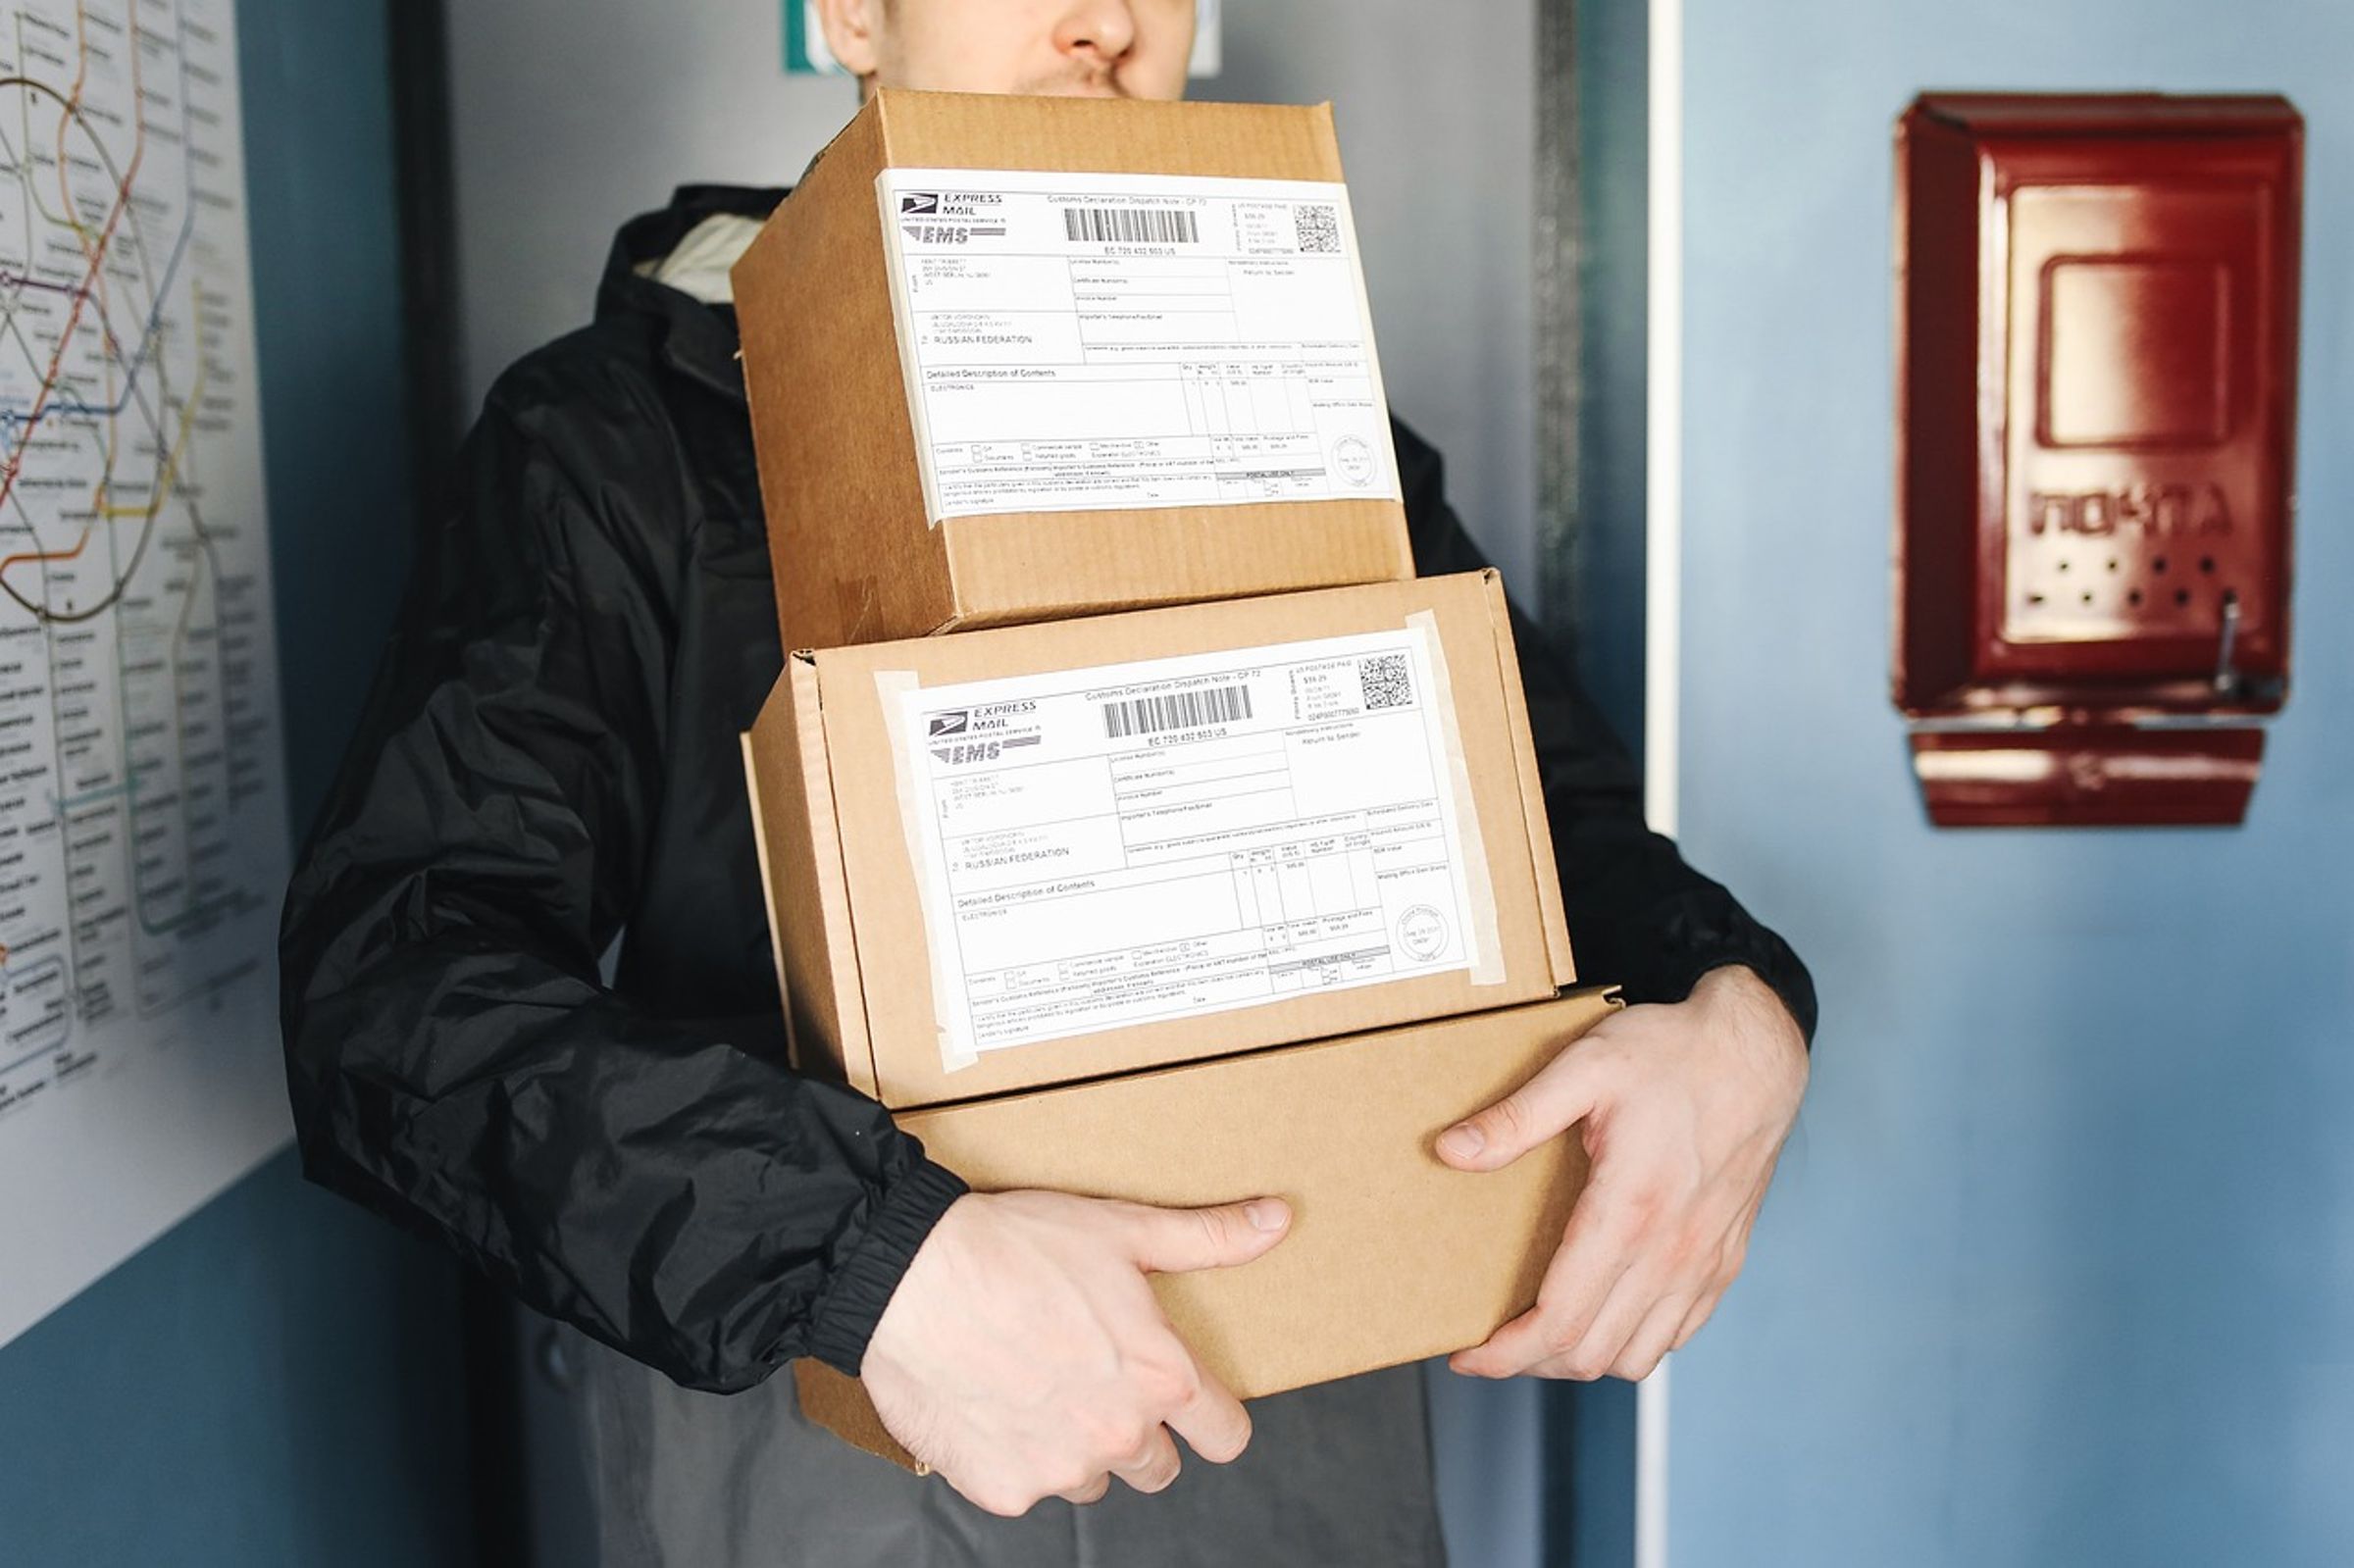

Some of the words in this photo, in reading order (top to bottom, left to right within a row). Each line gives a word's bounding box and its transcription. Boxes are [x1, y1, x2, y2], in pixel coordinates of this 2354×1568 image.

[944, 193, 1002, 203] EXPRESS
[1046, 194, 1082, 204] Customs
[1083, 195, 1126, 204] Declaration
[1129, 196, 1160, 205] Dispatch
[943, 206, 976, 216] MAIL
[919, 226, 968, 244] EMS
[1104, 246, 1116, 255] EC
[1164, 247, 1176, 256] US
[934, 335, 975, 344] RUSSIAN
[976, 335, 1033, 344] FEDERATION
[926, 371, 960, 379] Detailed
[961, 369, 1007, 379] Description
[1010, 369, 1018, 378] of
[1020, 369, 1056, 378] Contents
[2030, 481, 2234, 536] ПОЧТА
[1084, 688, 1123, 701] Customs
[1124, 682, 1172, 695] Declaration
[1174, 678, 1210, 688] Dispatch
[1237, 671, 1250, 681] CP
[974, 700, 1037, 718] EXPRESS
[972, 718, 1008, 731] MAIL
[1148, 736, 1160, 746] EC
[1213, 728, 1227, 737] US
[948, 740, 1000, 765] EMS
[965, 856, 1008, 870] RUSSIAN
[1008, 847, 1069, 863] FEDERATION
[957, 895, 993, 909] Detailed
[994, 888, 1043, 903] Description
[1046, 885, 1054, 894] of
[1056, 880, 1096, 892] Contents
